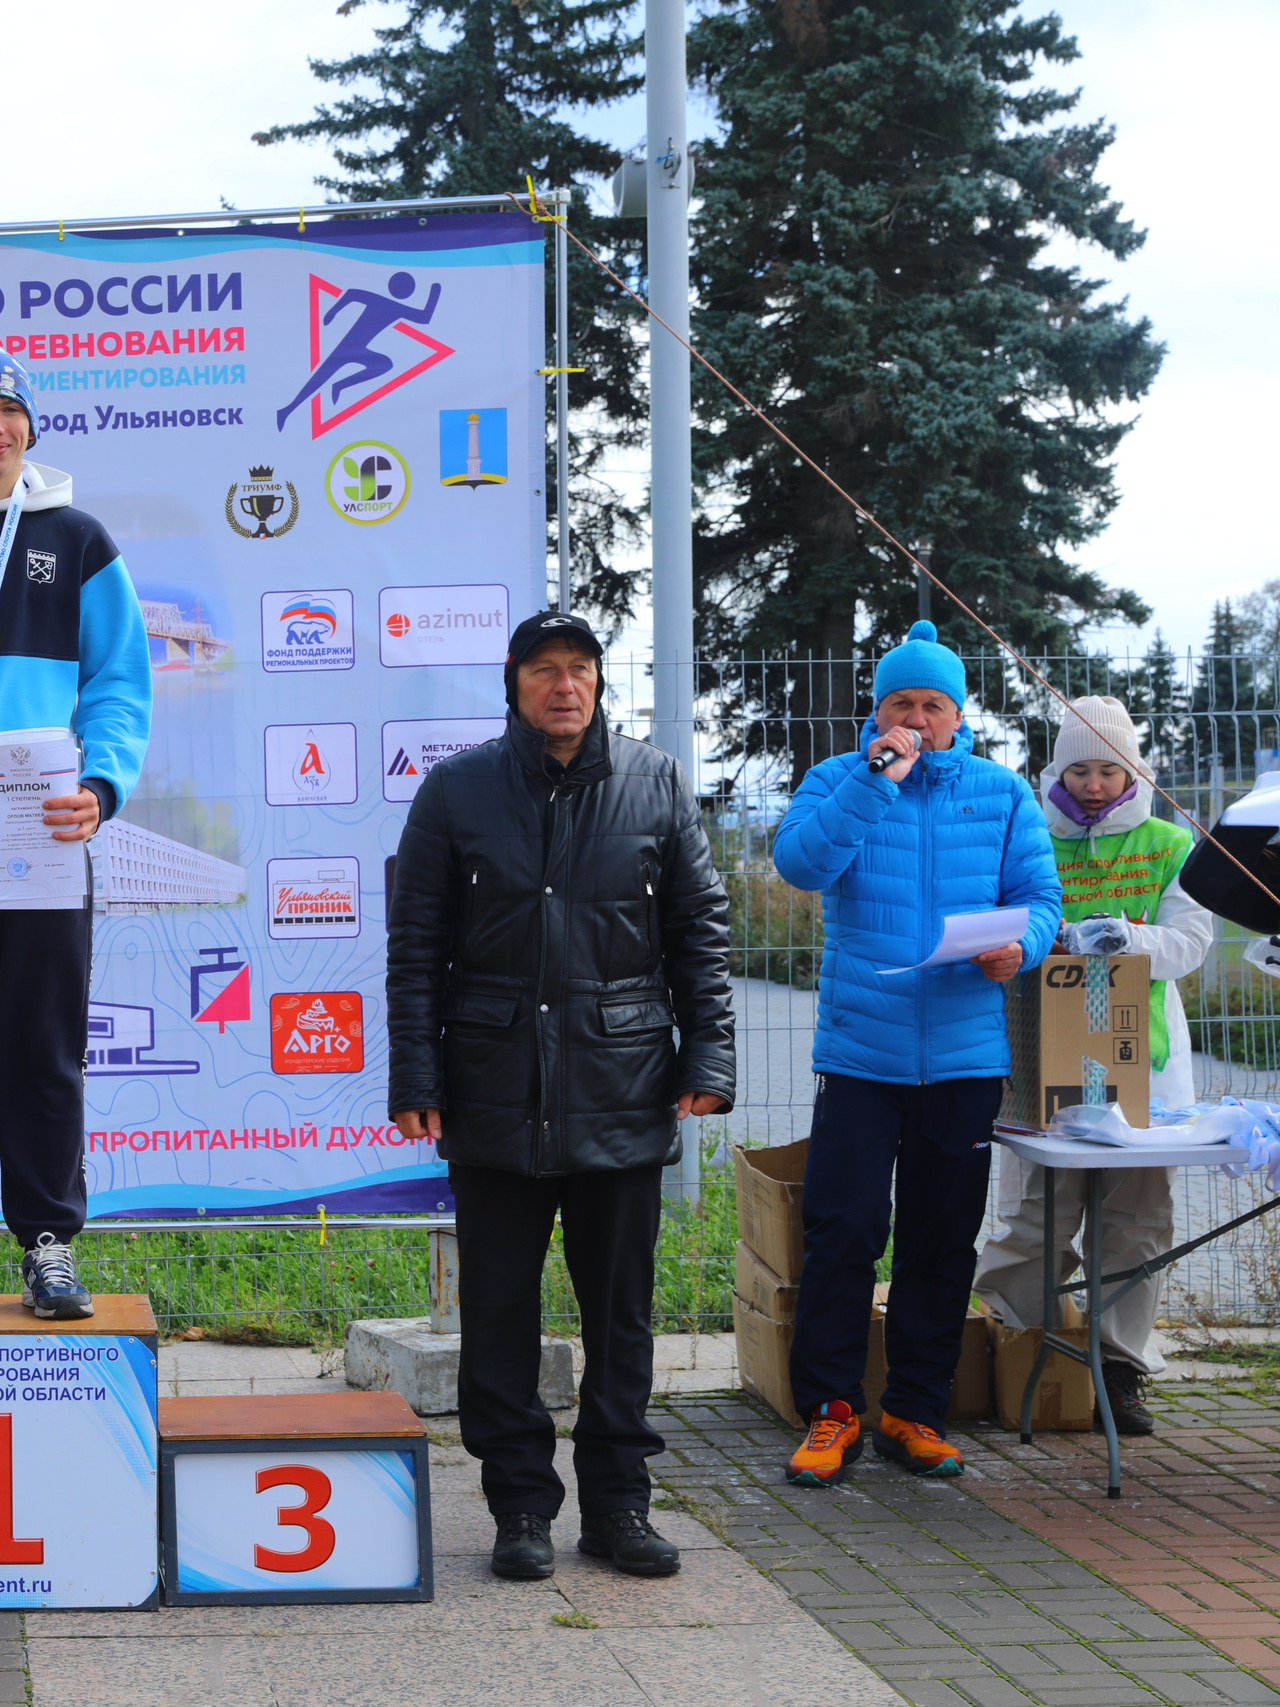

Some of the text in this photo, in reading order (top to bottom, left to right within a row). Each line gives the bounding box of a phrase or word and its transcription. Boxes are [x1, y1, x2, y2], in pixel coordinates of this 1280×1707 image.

[20, 272, 242, 319] РОССИИ
[29, 364, 246, 391] РИЕНТИРОВАНИЯ
[94, 405, 243, 430] Ульяновск
[241, 483, 282, 493] ТРИУМФ
[343, 502, 393, 512] УЛСПОРТ
[3, 526, 12, 548] СПОРТА
[8, 504, 18, 526] РОССИИ
[417, 608, 503, 629] azimut
[266, 657, 354, 667] РЕГИОНАЛЬНЫХ ПРОЕКТОВ
[267, 647, 352, 658] ФОНД ПОДДЕРЖКИ
[276, 887, 352, 915] Ульяновский
[288, 902, 352, 914] ПРЯНИК
[1046, 964, 1121, 988] CDK
[89, 1121, 318, 1152] ПРОПИТАННЫЙ
[22, 1387, 106, 1401] ОБЛАСТИ
[254, 1463, 336, 1573] 3
